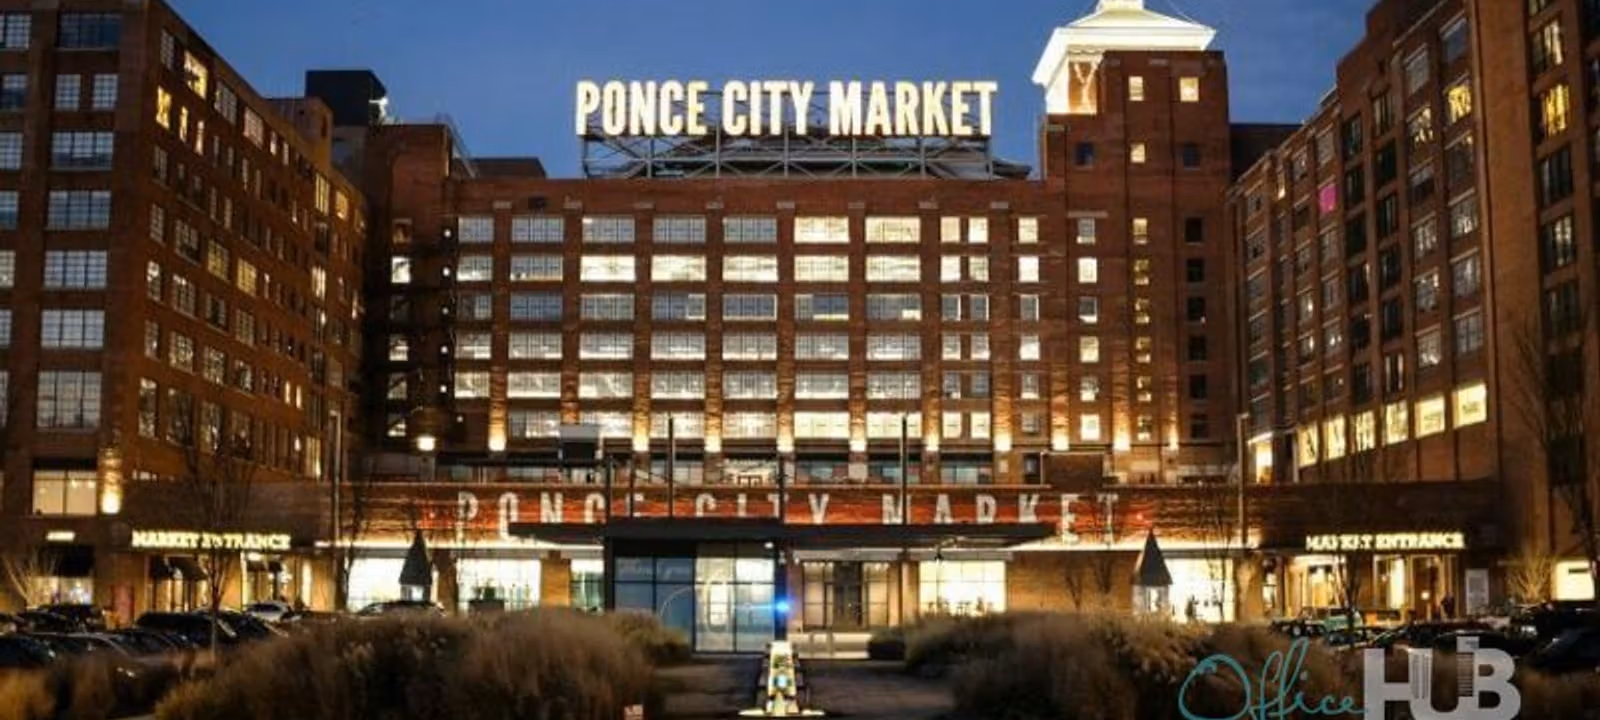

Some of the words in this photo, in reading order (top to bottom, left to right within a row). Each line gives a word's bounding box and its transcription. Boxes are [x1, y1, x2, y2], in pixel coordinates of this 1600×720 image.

[576, 80, 708, 136] PONCE
[721, 80, 814, 136] CITY
[828, 80, 997, 136] MARKET
[131, 531, 199, 548] MARKET
[1375, 531, 1465, 549] ENTRANCE
